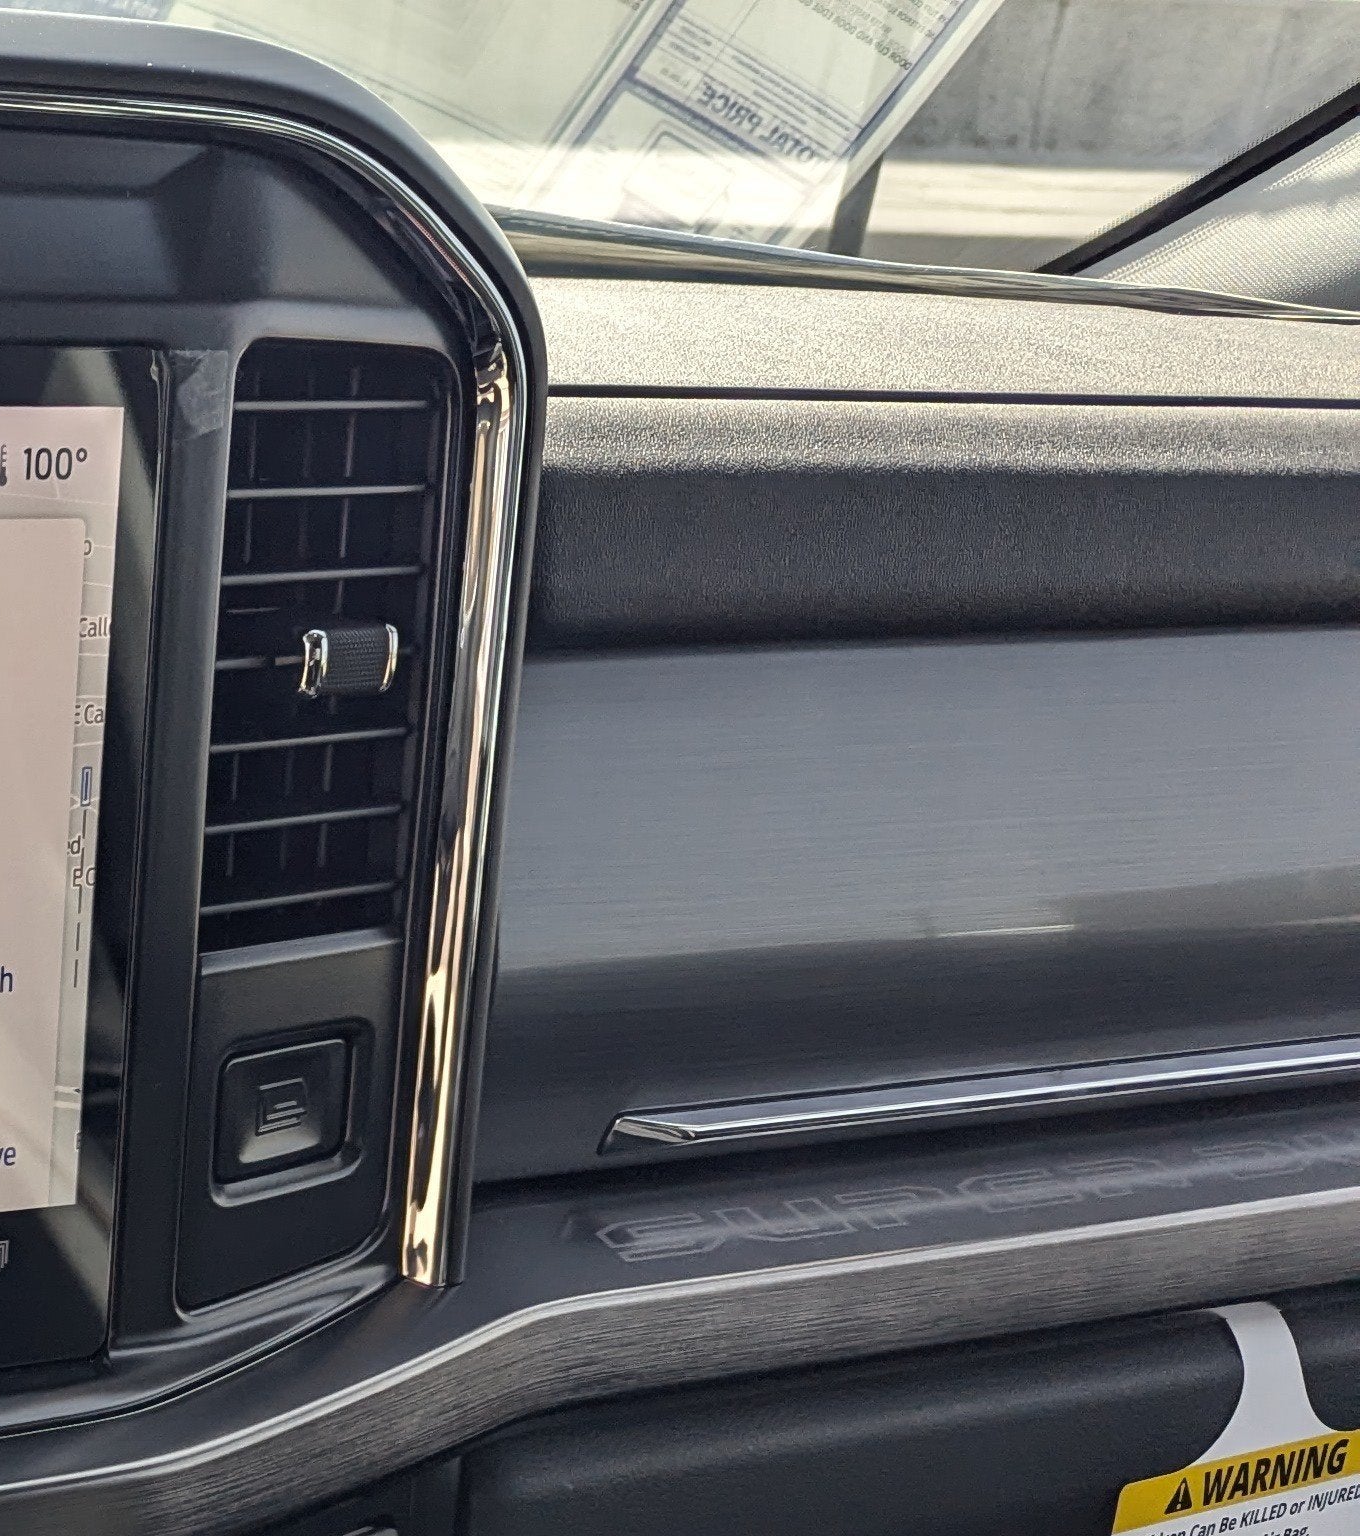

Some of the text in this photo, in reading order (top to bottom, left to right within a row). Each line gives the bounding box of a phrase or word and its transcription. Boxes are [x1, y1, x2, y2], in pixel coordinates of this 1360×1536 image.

[1201, 1438, 1351, 1507] WARNING
[1218, 1515, 1238, 1535] Be
[1239, 1501, 1288, 1528] KILLED
[1289, 1500, 1306, 1516] or
